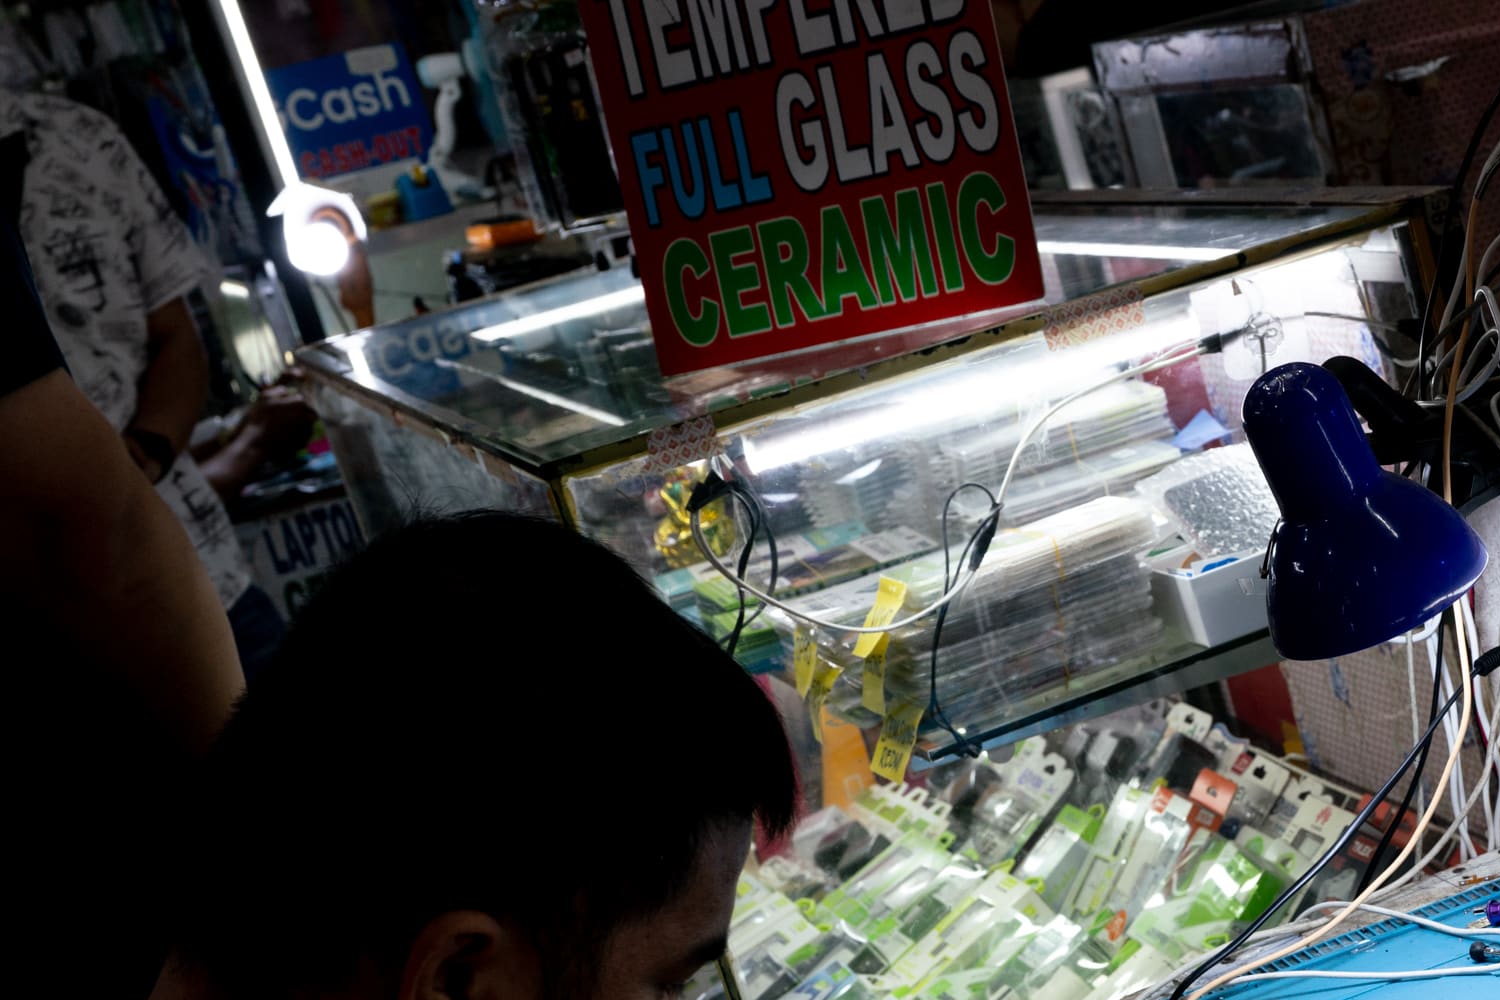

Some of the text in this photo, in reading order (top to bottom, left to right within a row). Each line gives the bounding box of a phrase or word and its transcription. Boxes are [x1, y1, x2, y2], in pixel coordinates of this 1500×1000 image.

[608, 0, 964, 97] TEMPE
[300, 126, 423, 178] CASH-OUT
[630, 31, 999, 227] FULL GLASS
[663, 171, 1016, 347] CERAMIC
